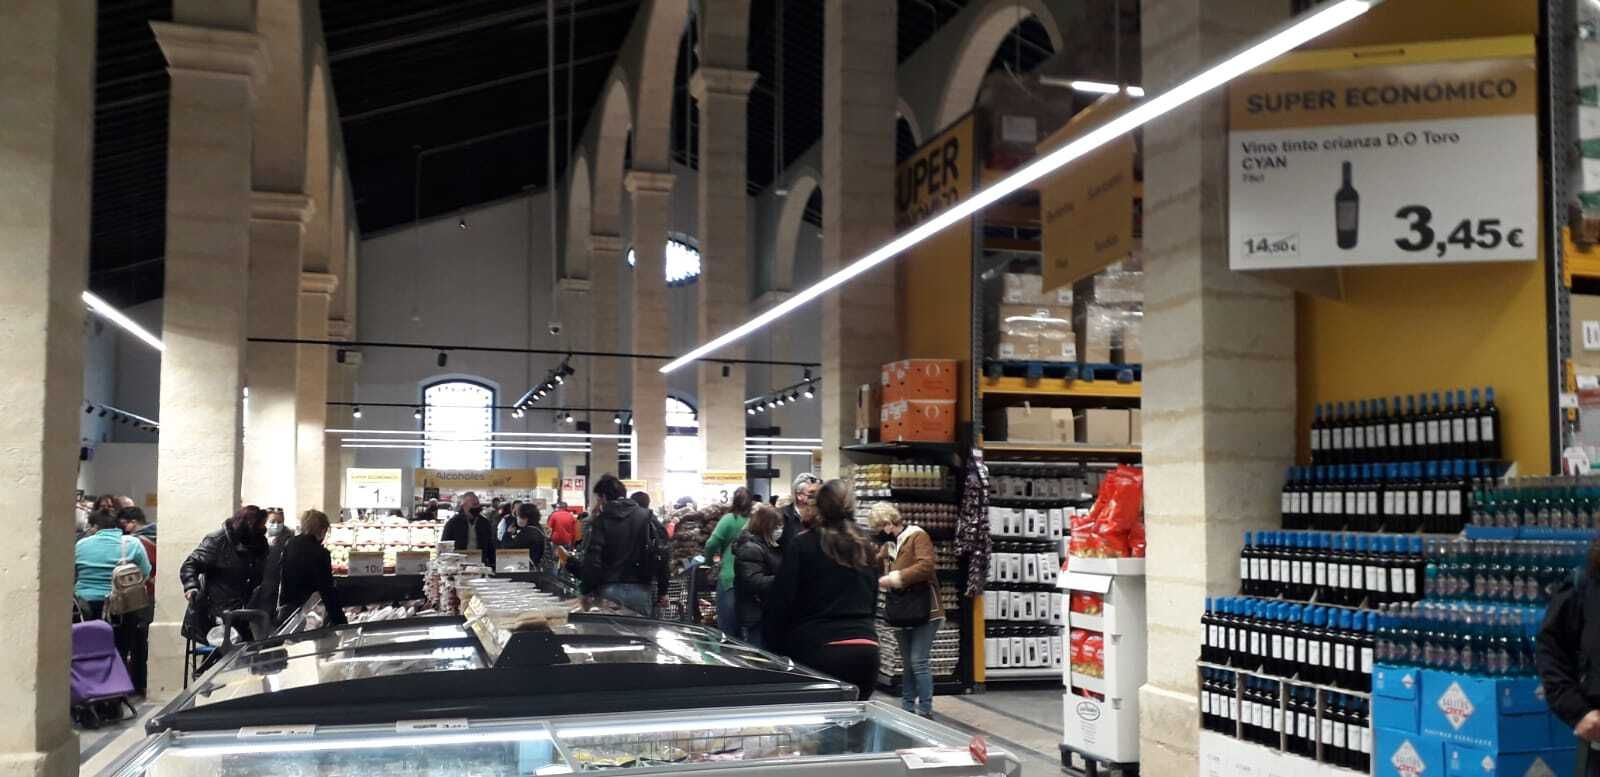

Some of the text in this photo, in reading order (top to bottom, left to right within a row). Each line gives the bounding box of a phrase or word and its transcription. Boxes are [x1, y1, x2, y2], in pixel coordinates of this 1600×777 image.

[1246, 77, 1518, 114] SUPER ECONÓMICO
[1241, 140, 1278, 155] Vino
[1282, 138, 1318, 152] tinto
[1323, 134, 1382, 149] crianza
[1423, 129, 1461, 144] Toro
[896, 136, 961, 214] UPER
[1241, 154, 1288, 171] CYAN
[436, 471, 486, 482] Alcoholes
